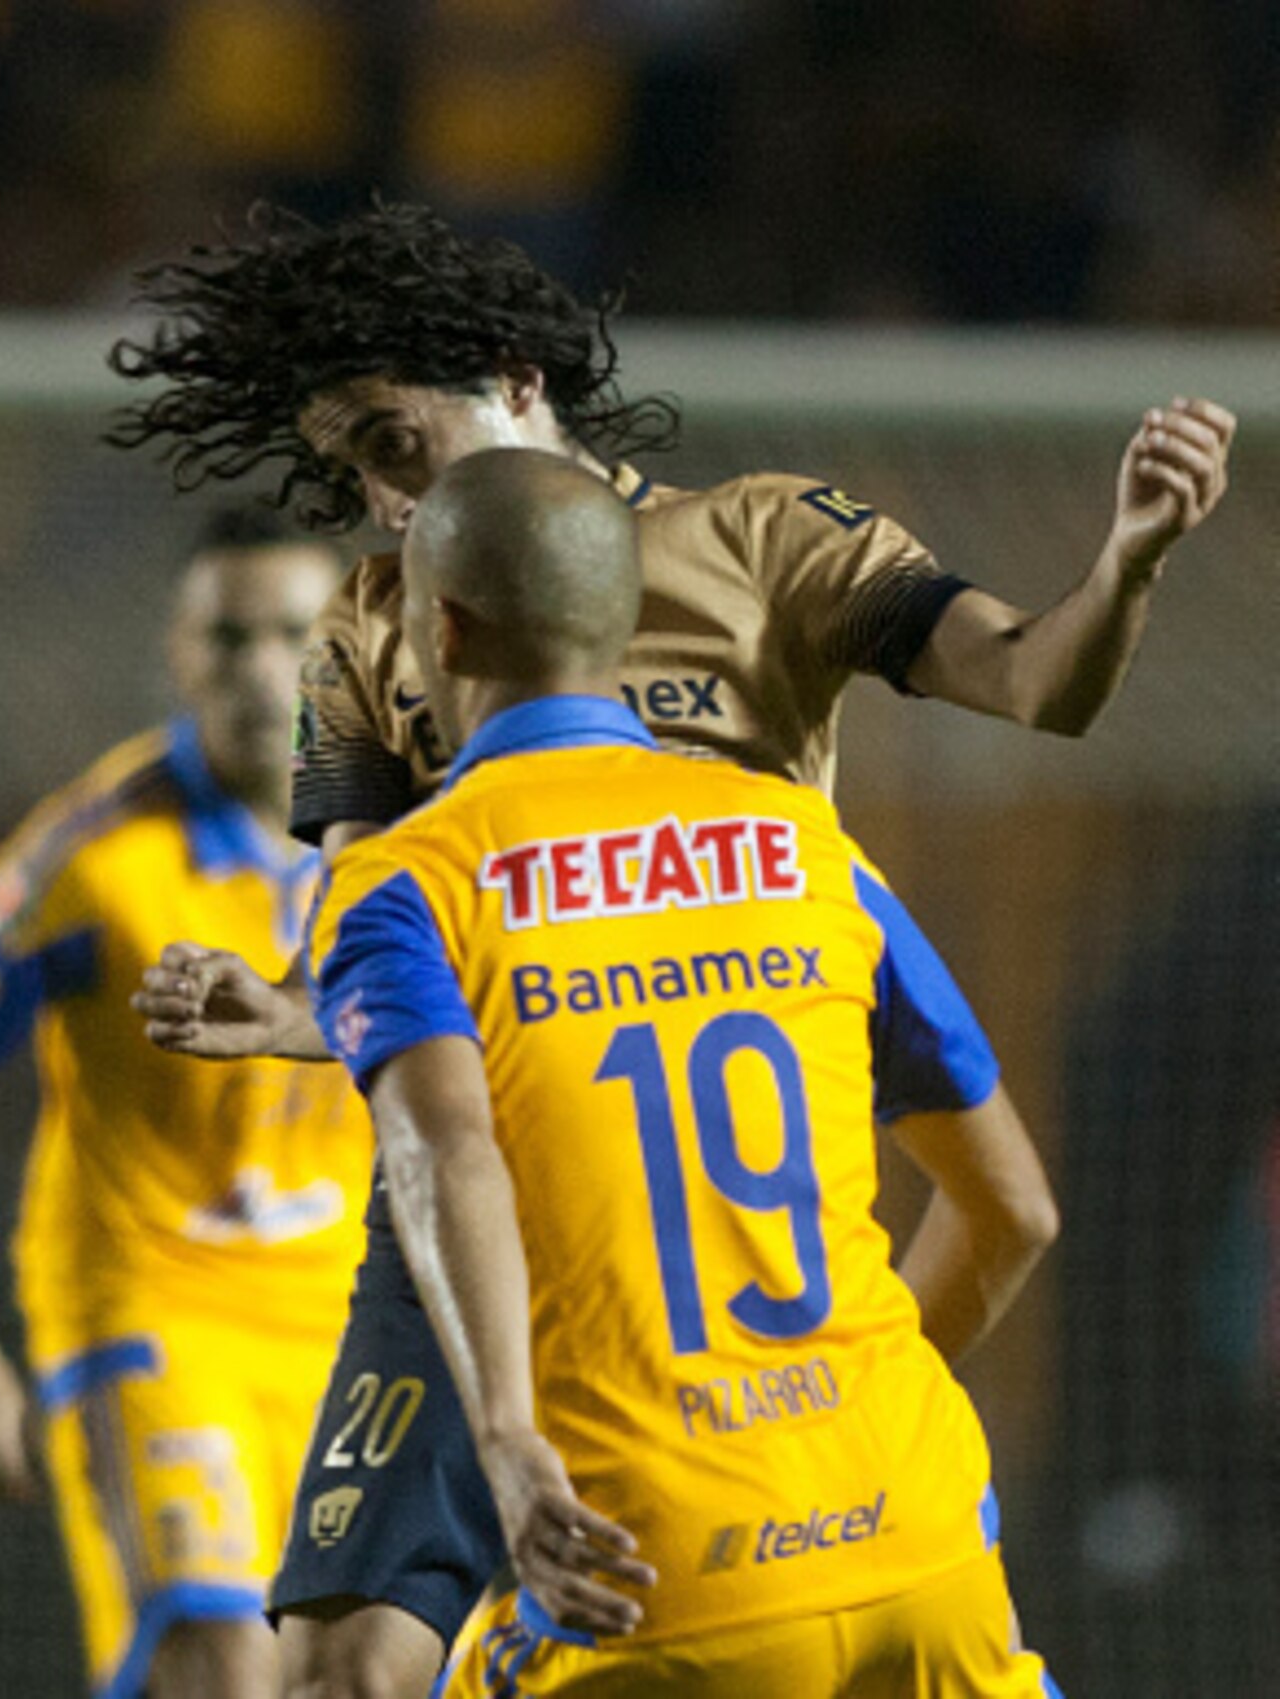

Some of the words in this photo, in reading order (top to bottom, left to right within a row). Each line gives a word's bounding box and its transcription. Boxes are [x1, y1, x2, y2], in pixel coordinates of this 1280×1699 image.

[480, 814, 806, 930] TECATE
[510, 945, 827, 1023] Banamex
[592, 1010, 833, 1355] 19
[323, 1373, 425, 1467] 20
[677, 1357, 840, 1438] PIZARRO
[753, 1490, 886, 1564] telcel
